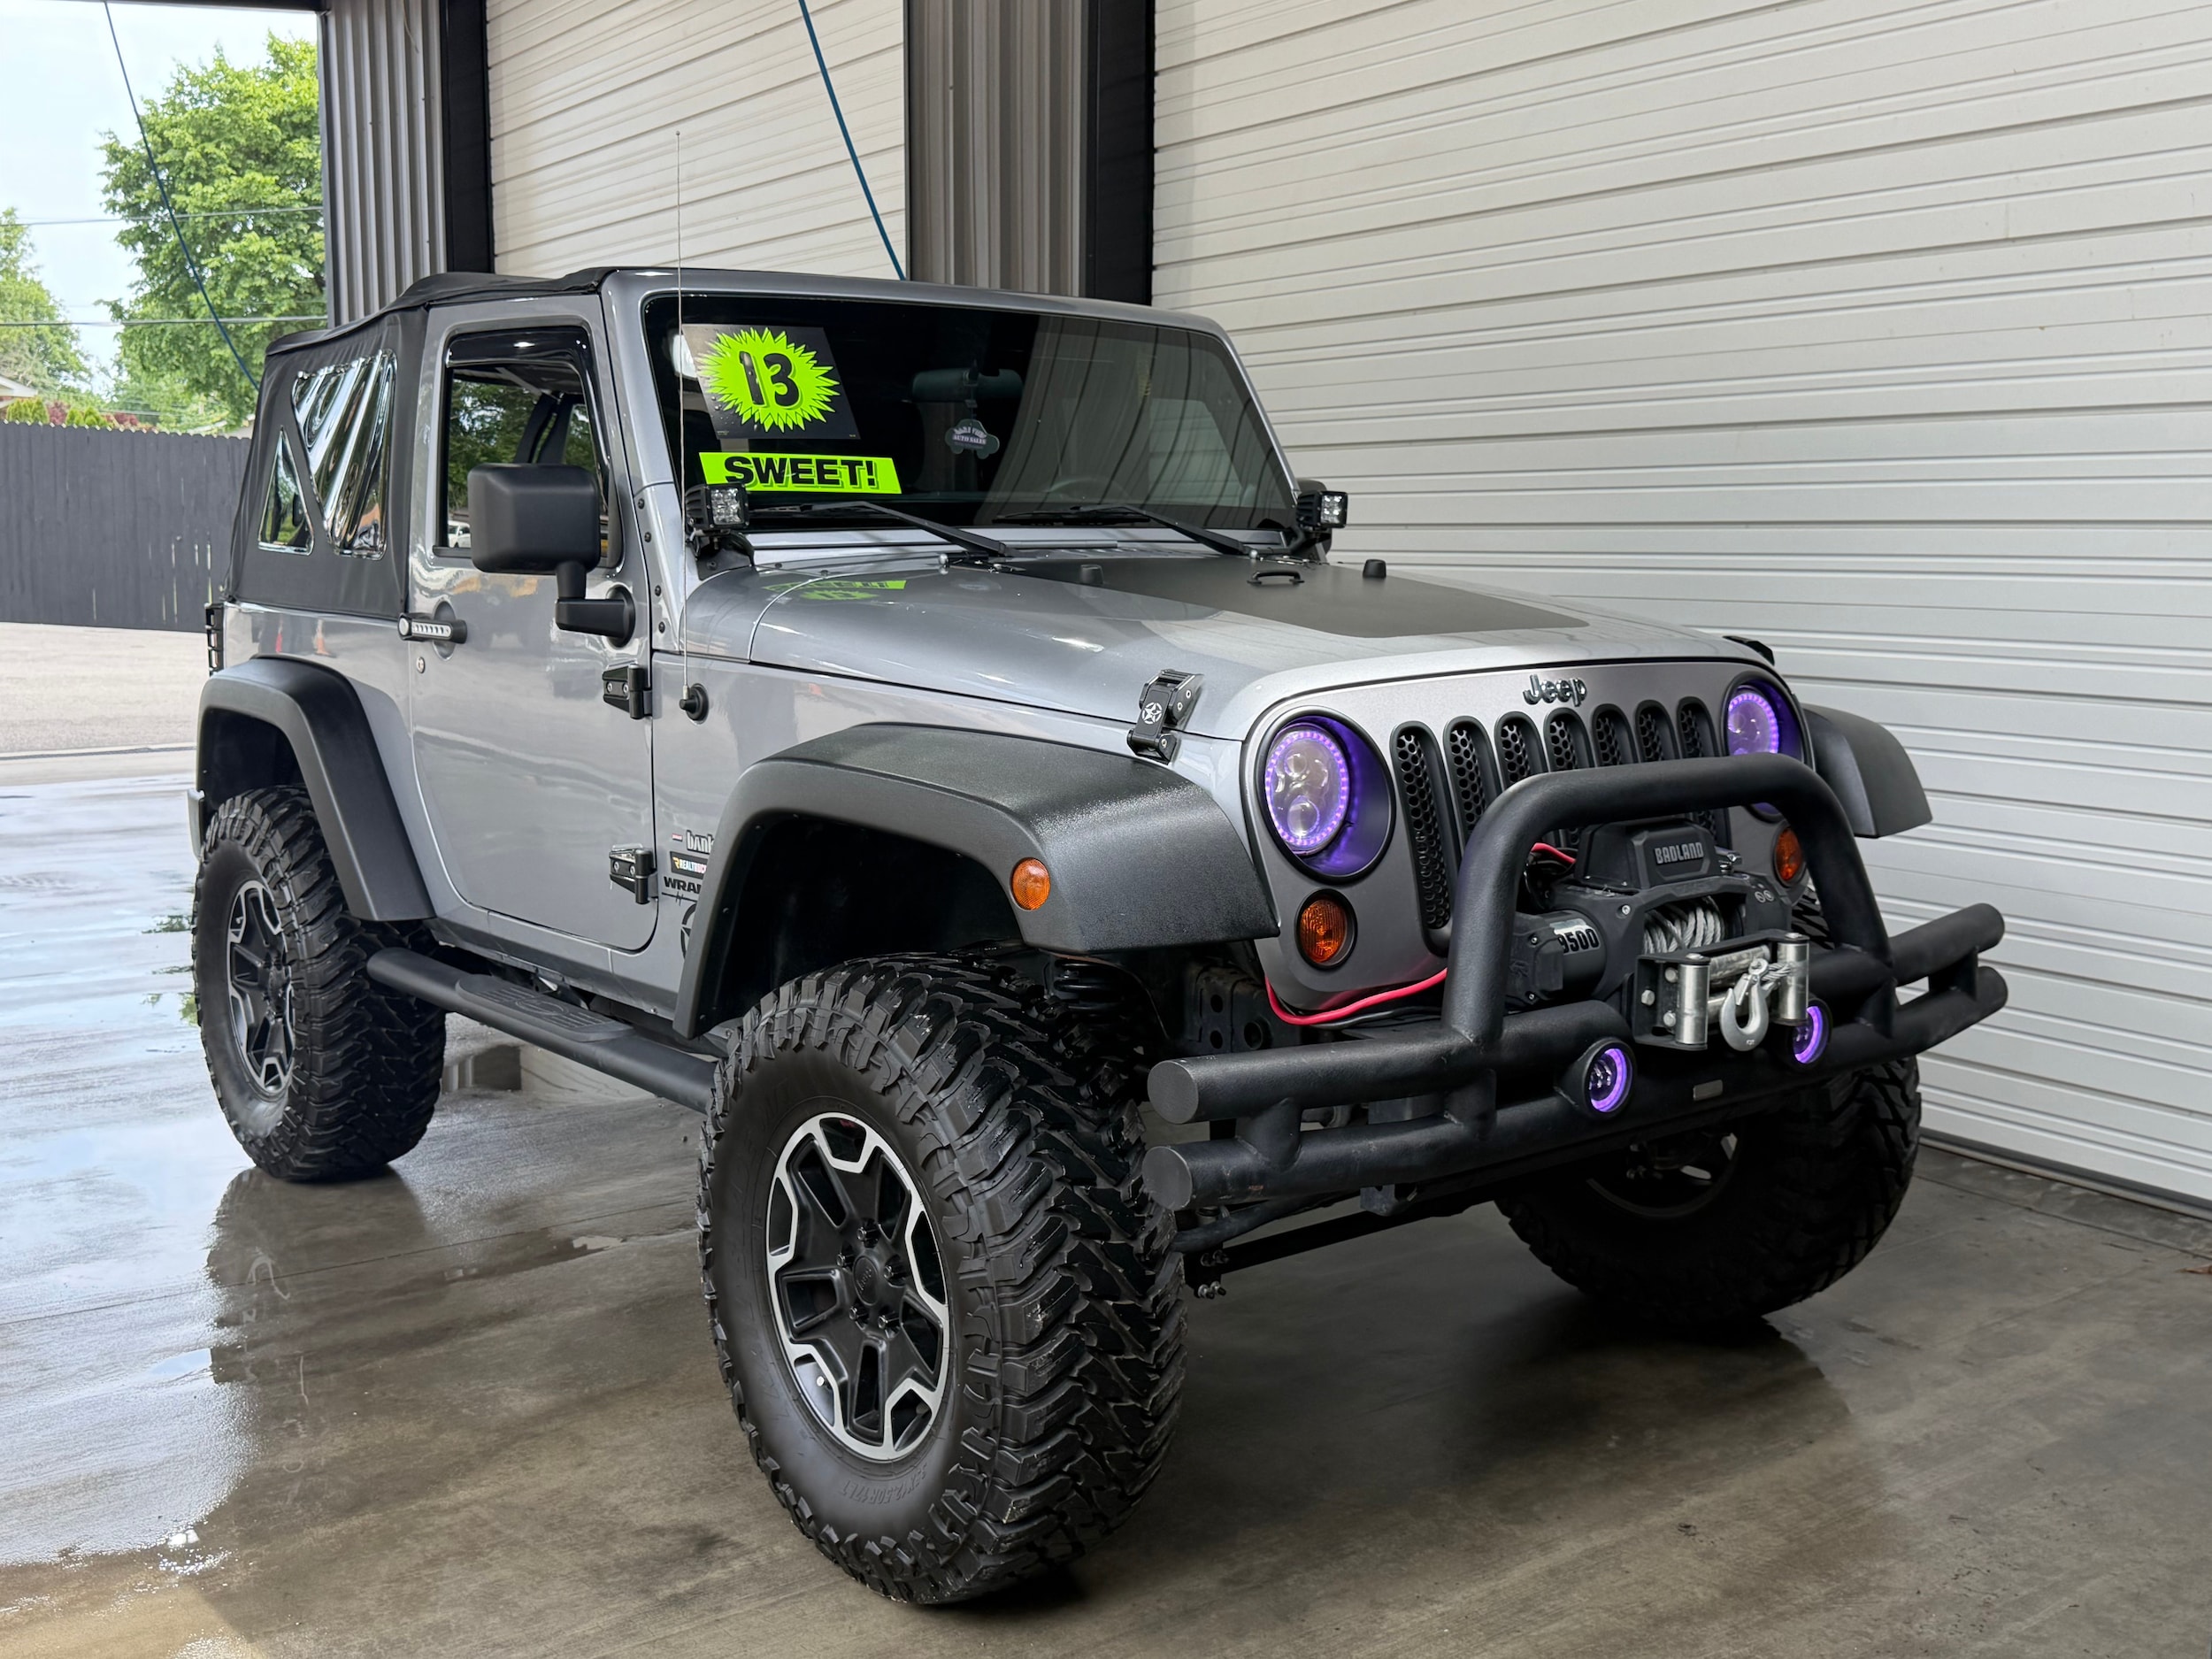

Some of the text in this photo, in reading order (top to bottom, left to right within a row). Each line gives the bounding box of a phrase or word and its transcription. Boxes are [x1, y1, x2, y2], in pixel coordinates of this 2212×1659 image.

[739, 350, 801, 408] 13
[725, 456, 878, 488] SWEET!
[1523, 674, 1587, 707] Jeep
[1654, 841, 1705, 865] BADLAND
[1557, 928, 1600, 954] 9500
